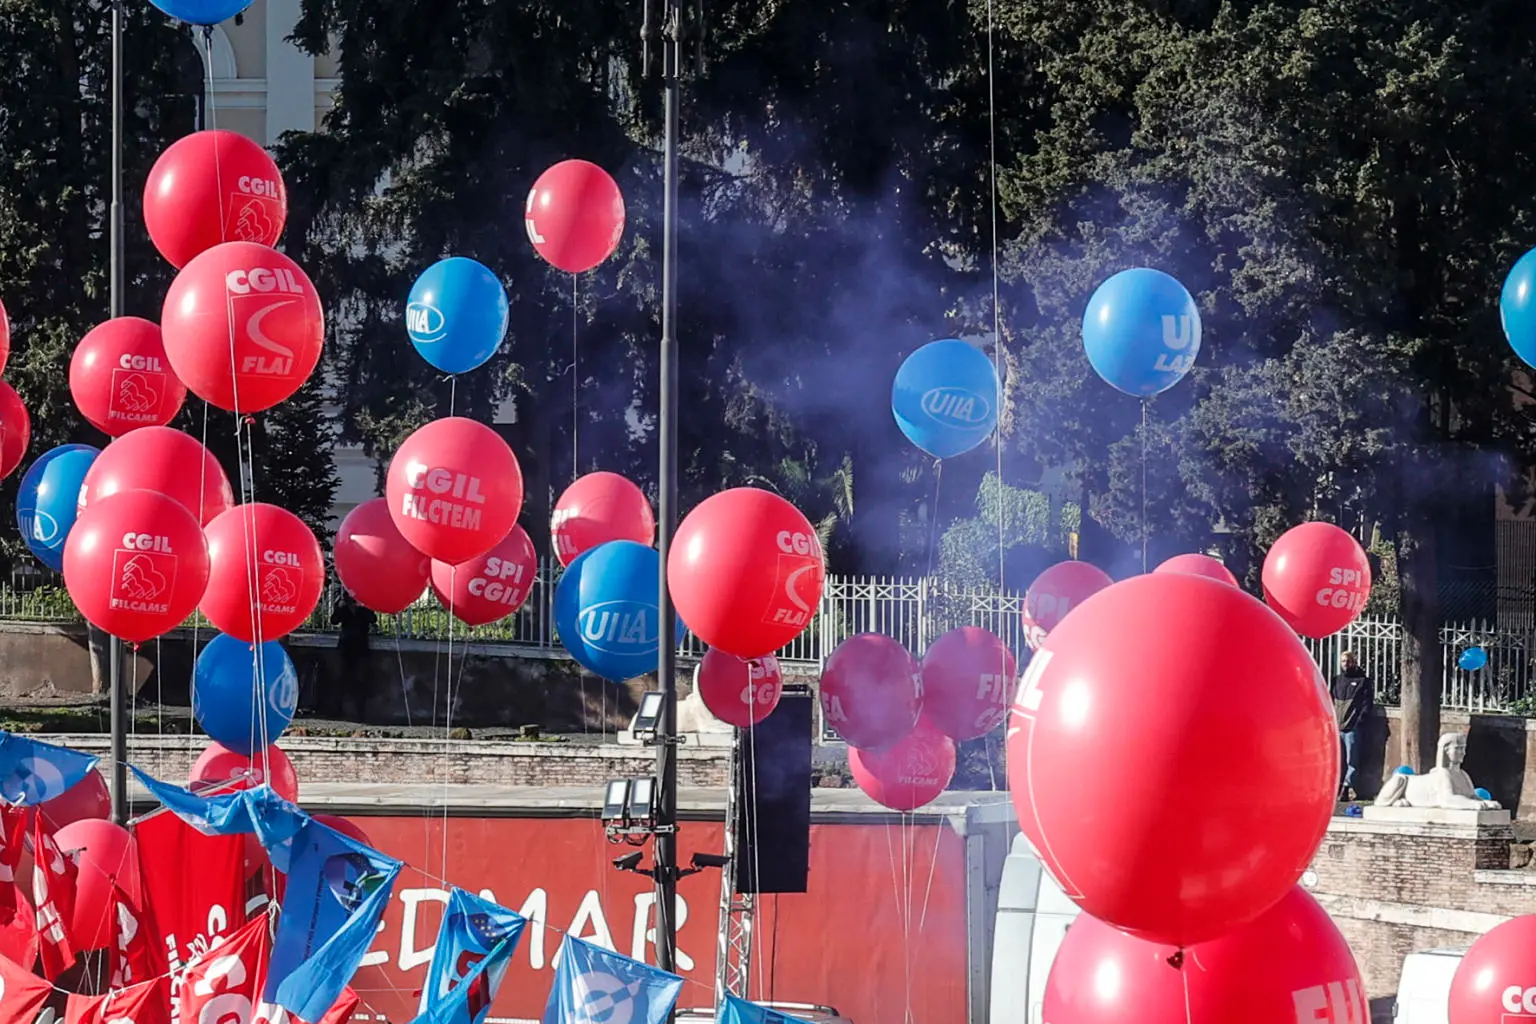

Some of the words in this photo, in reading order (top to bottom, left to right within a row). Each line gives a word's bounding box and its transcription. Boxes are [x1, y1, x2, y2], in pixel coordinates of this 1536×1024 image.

[238, 176, 278, 199] CGIL
[226, 269, 303, 294] CGIL
[119, 353, 162, 373] CGIL
[242, 355, 293, 376] FLAI
[109, 409, 159, 424] FILCAMS
[929, 392, 977, 420] UILA
[406, 463, 486, 504] CGIL
[402, 493, 482, 531] FILCTEM
[123, 532, 173, 554] CGIL
[263, 550, 301, 567] CGIL
[484, 556, 523, 584] SPI
[1328, 566, 1362, 588] SPI
[468, 577, 521, 606] CGIL
[111, 598, 169, 613] FILCAMS
[585, 606, 647, 643] UILA
